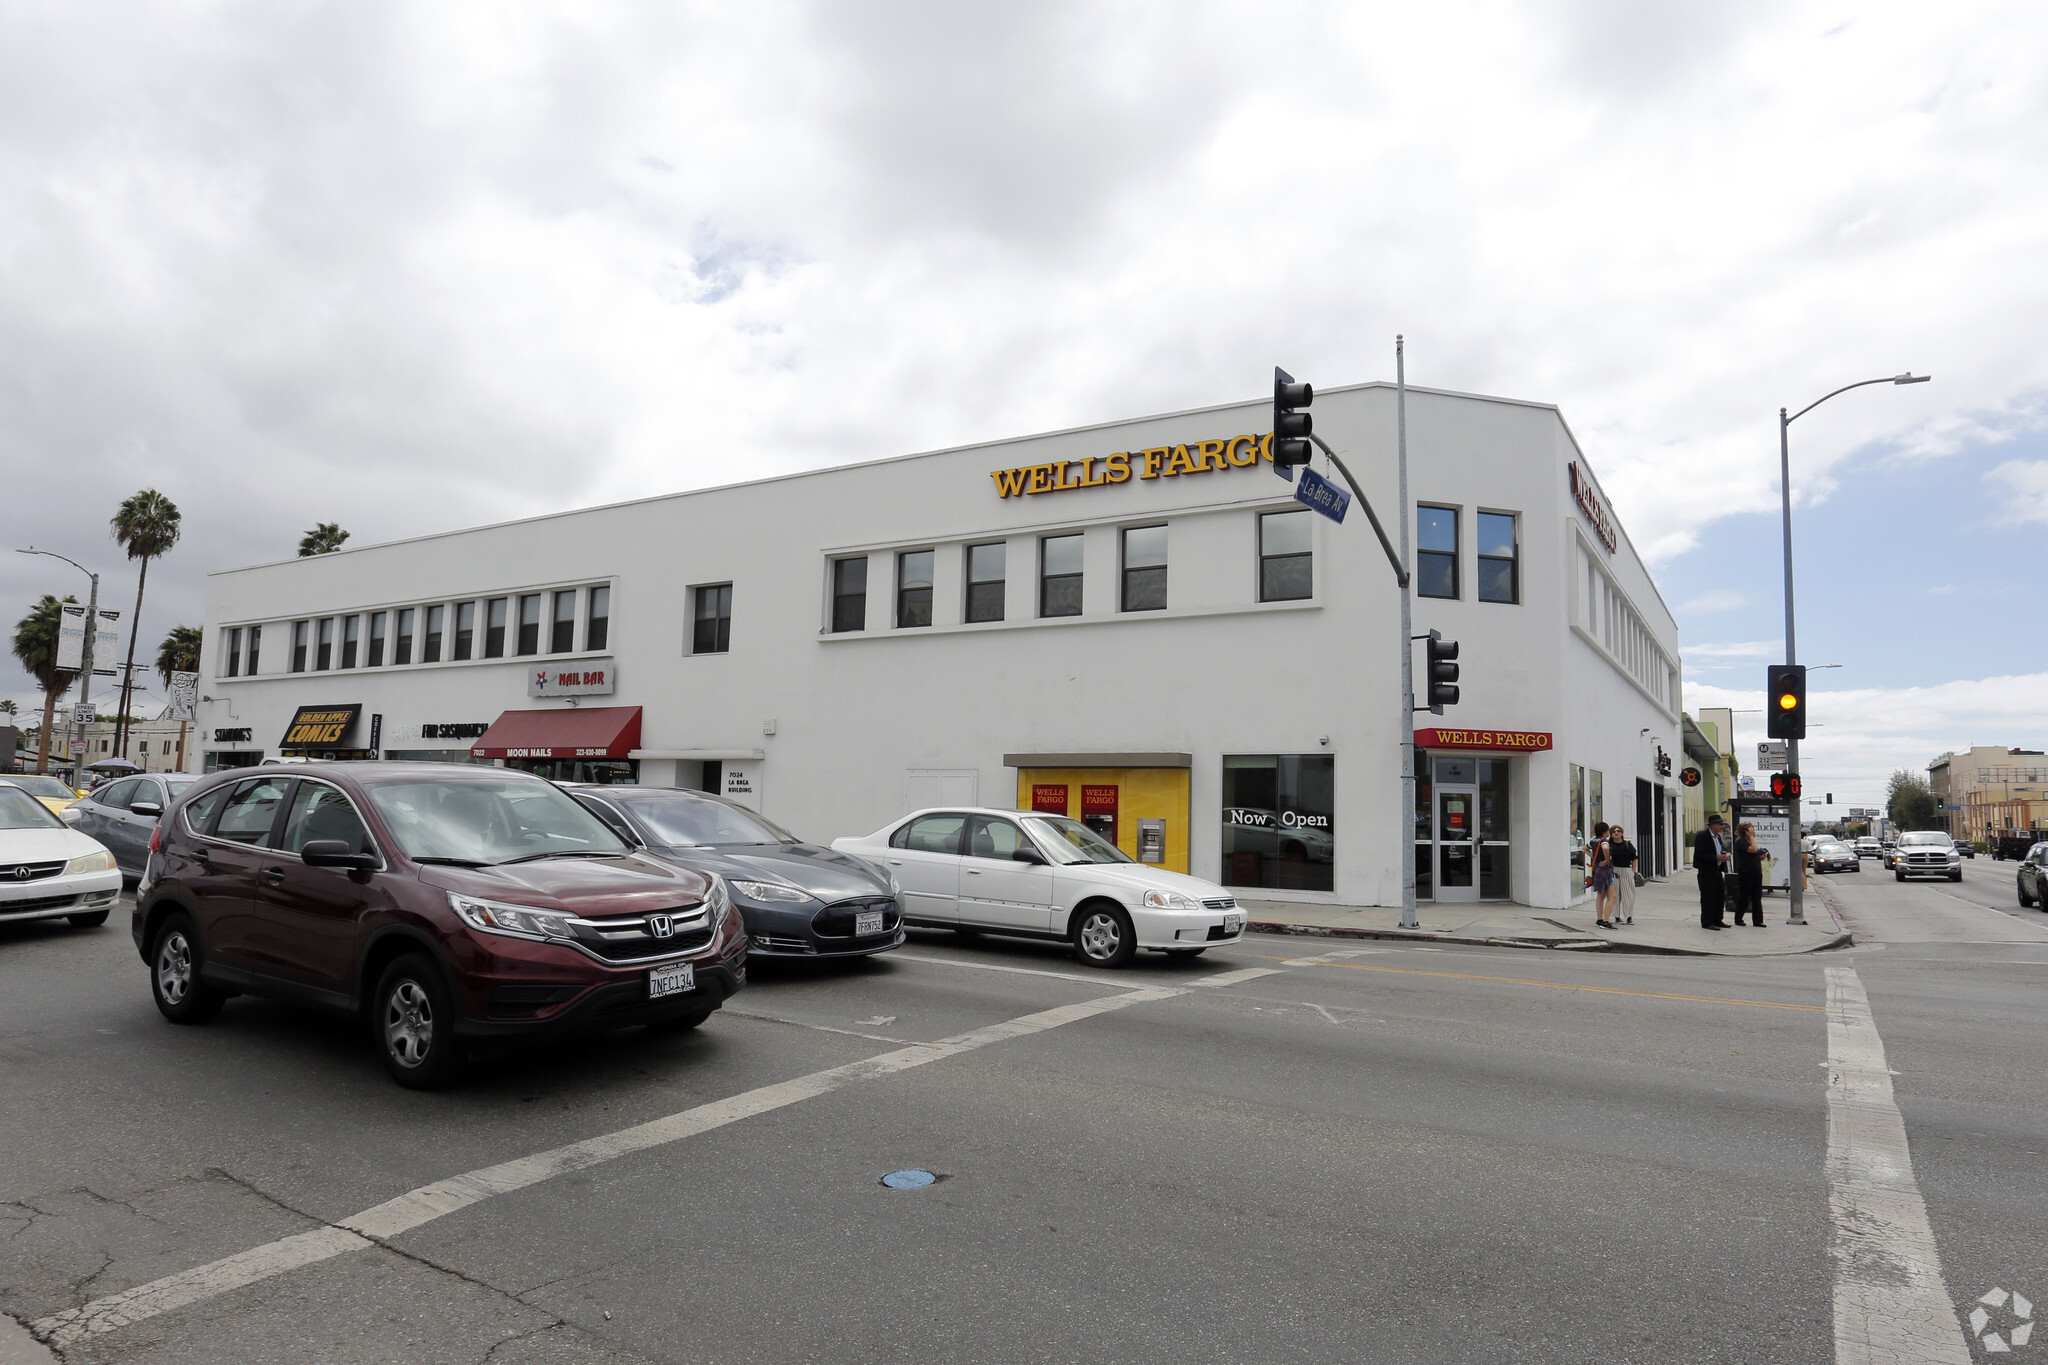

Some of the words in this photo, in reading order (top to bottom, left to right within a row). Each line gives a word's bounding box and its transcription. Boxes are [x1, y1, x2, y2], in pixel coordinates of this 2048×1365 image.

[989, 451, 1133, 499] WELLS
[1302, 476, 1315, 497] La
[1313, 483, 1333, 507] Brea
[1331, 494, 1344, 513] Av
[559, 673, 580, 686] NAIL
[583, 672, 604, 685] BAR
[77, 714, 93, 722] 35
[298, 713, 327, 722] GOLDEN
[325, 712, 349, 722] APPLE
[286, 724, 346, 742] COMICS
[1436, 730, 1492, 745] WELLS
[1496, 733, 1548, 747] FARGO
[507, 748, 528, 757] MOON
[530, 748, 552, 757] NAILS
[1790, 778, 1799, 794] 0
[1230, 810, 1268, 825] Now
[1282, 811, 1328, 830] Open
